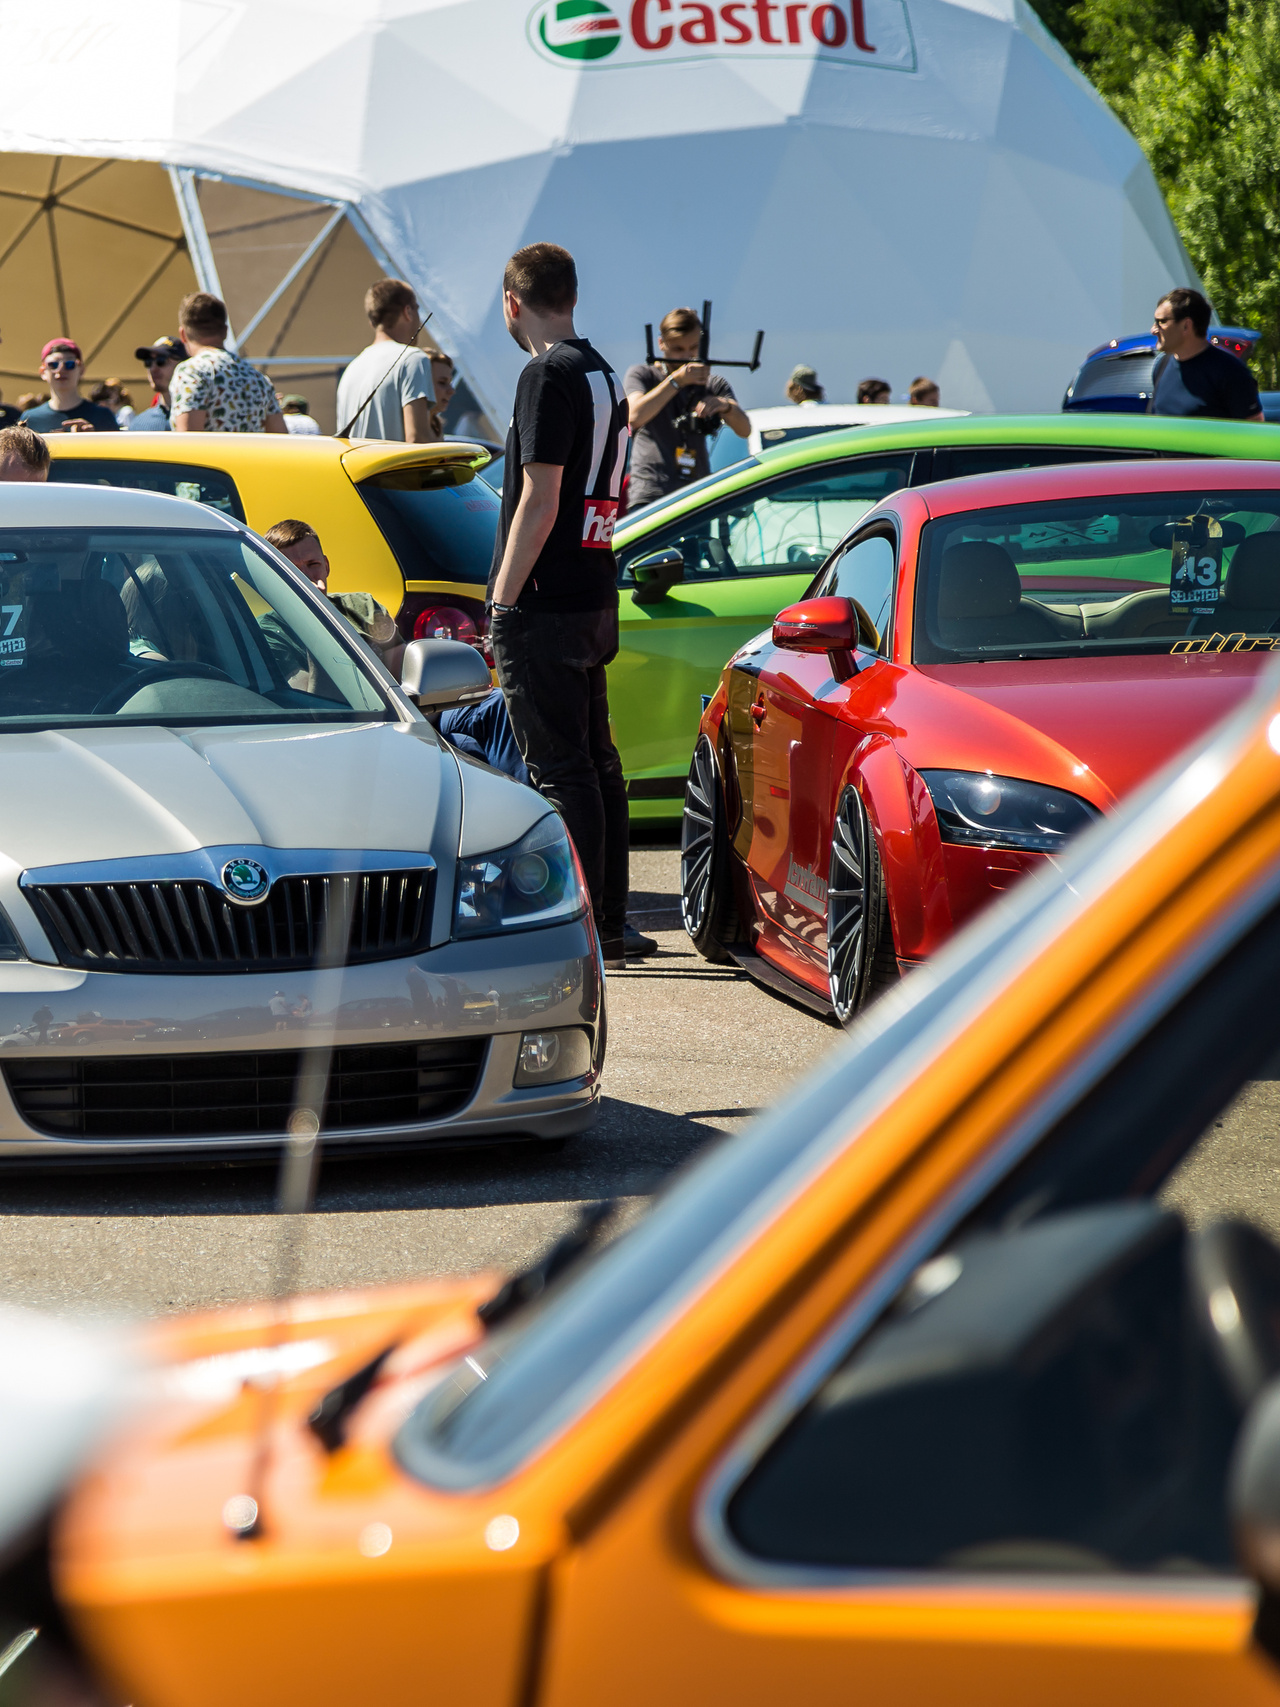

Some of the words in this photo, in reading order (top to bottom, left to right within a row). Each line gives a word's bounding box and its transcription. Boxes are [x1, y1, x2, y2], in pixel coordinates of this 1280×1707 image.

[629, 0, 877, 51] Castrol
[1175, 556, 1218, 586] 43
[1171, 588, 1219, 603] SELECTED
